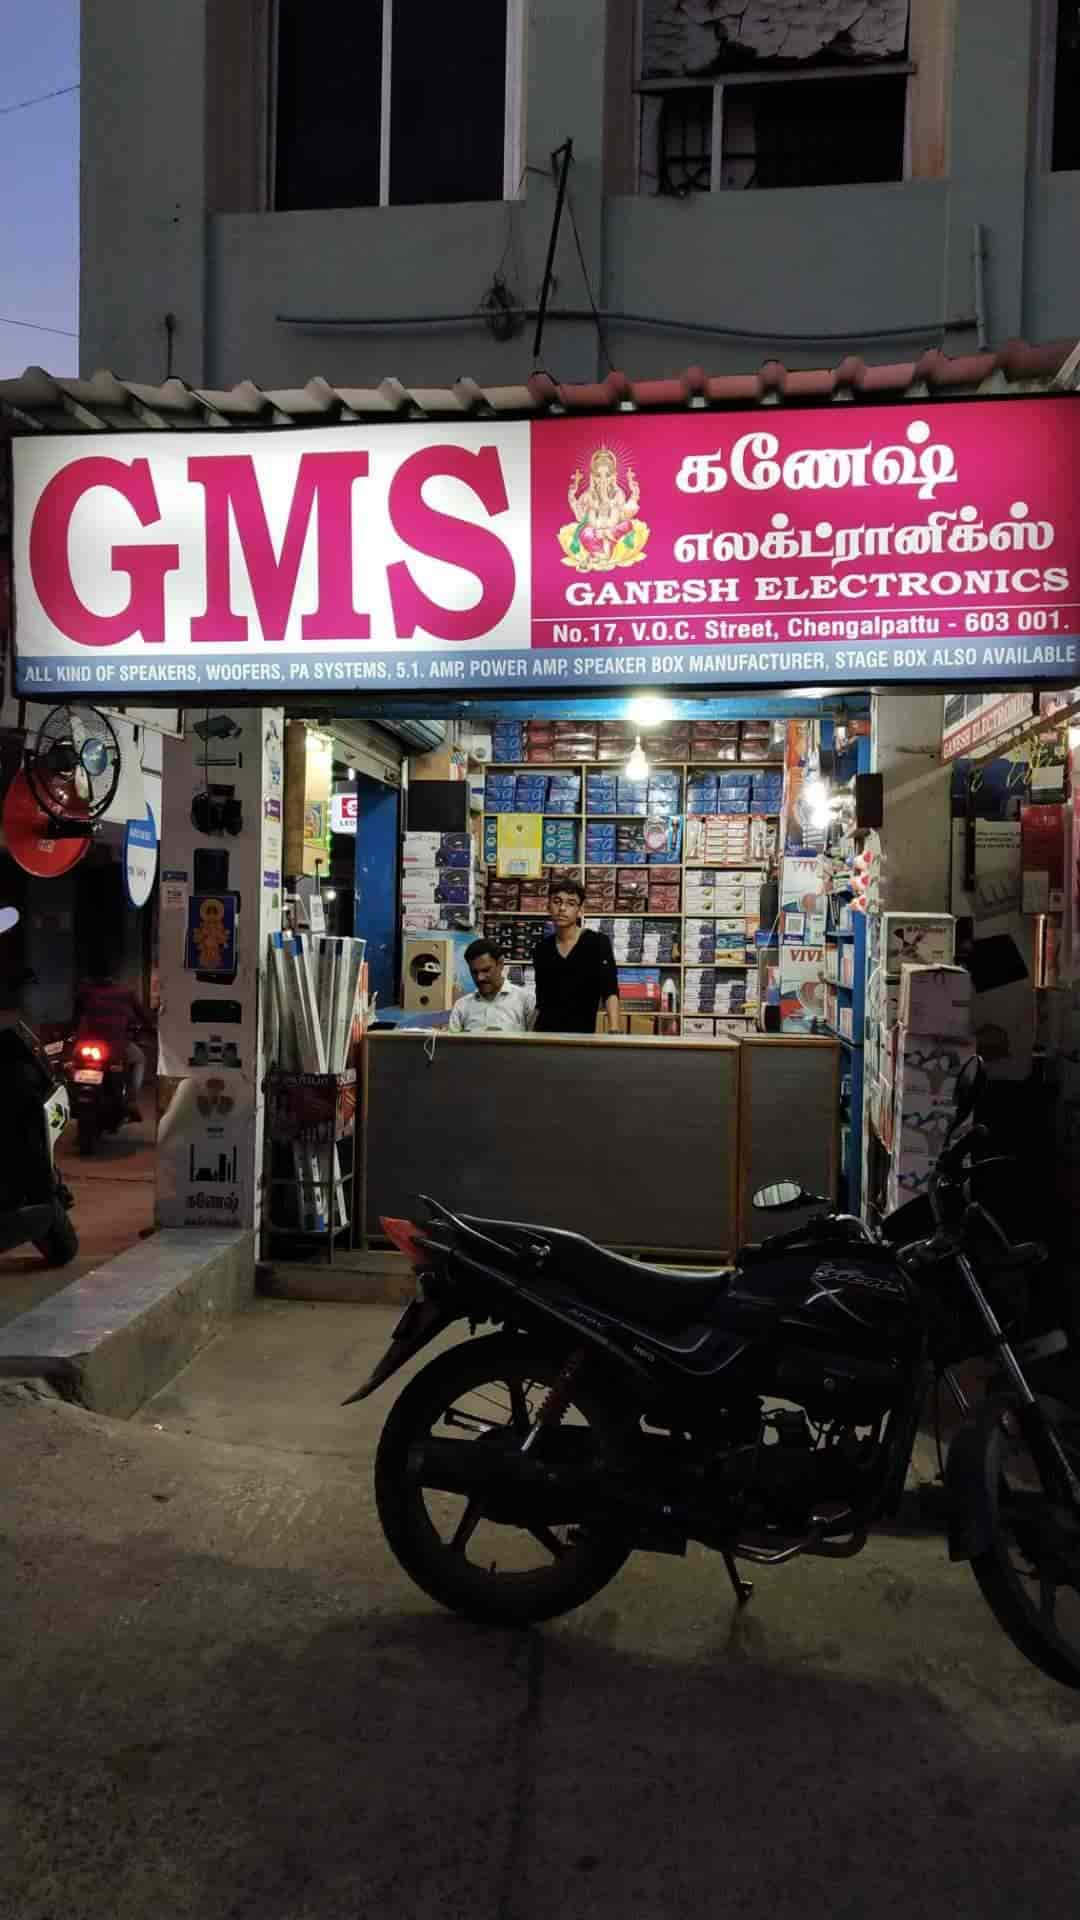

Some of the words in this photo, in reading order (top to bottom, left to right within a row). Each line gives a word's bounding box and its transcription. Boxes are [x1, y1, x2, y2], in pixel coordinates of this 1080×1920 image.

[675, 420, 958, 499] கணேஷ்
[29, 444, 516, 647] GMS
[673, 501, 1055, 568] எலக்ட்ரானிக்ஸ்
[564, 577, 740, 606] GANESH
[754, 567, 1070, 602] ELECTRONICS
[552, 623, 624, 644] No.17,
[631, 621, 697, 641] V.O.C.
[704, 619, 779, 641] Street,
[787, 615, 940, 640] Chengalpattu
[964, 612, 1010, 632] 603
[1017, 610, 1070, 631] 001.
[24, 666, 53, 682] ALL
[56, 664, 91, 681] KIND
[95, 664, 116, 680] OF
[119, 663, 201, 683] SPEAKERS,
[206, 662, 286, 682] WOOFERS,
[289, 662, 310, 679] PA
[313, 661, 392, 680] SYSTEMS,
[396, 662, 425, 679] 5.1.
[428, 661, 465, 680] AMP,
[470, 659, 528, 677] POWER
[532, 658, 568, 678] AMP,
[573, 656, 647, 675] SPEAKER
[651, 655, 684, 673] BOX
[688, 651, 830, 673] MANUFACTURER,
[835, 650, 889, 669] STAGE
[893, 649, 927, 668] BOX
[931, 647, 977, 666] ALSO
[982, 645, 1076, 665] AVAILABLE
